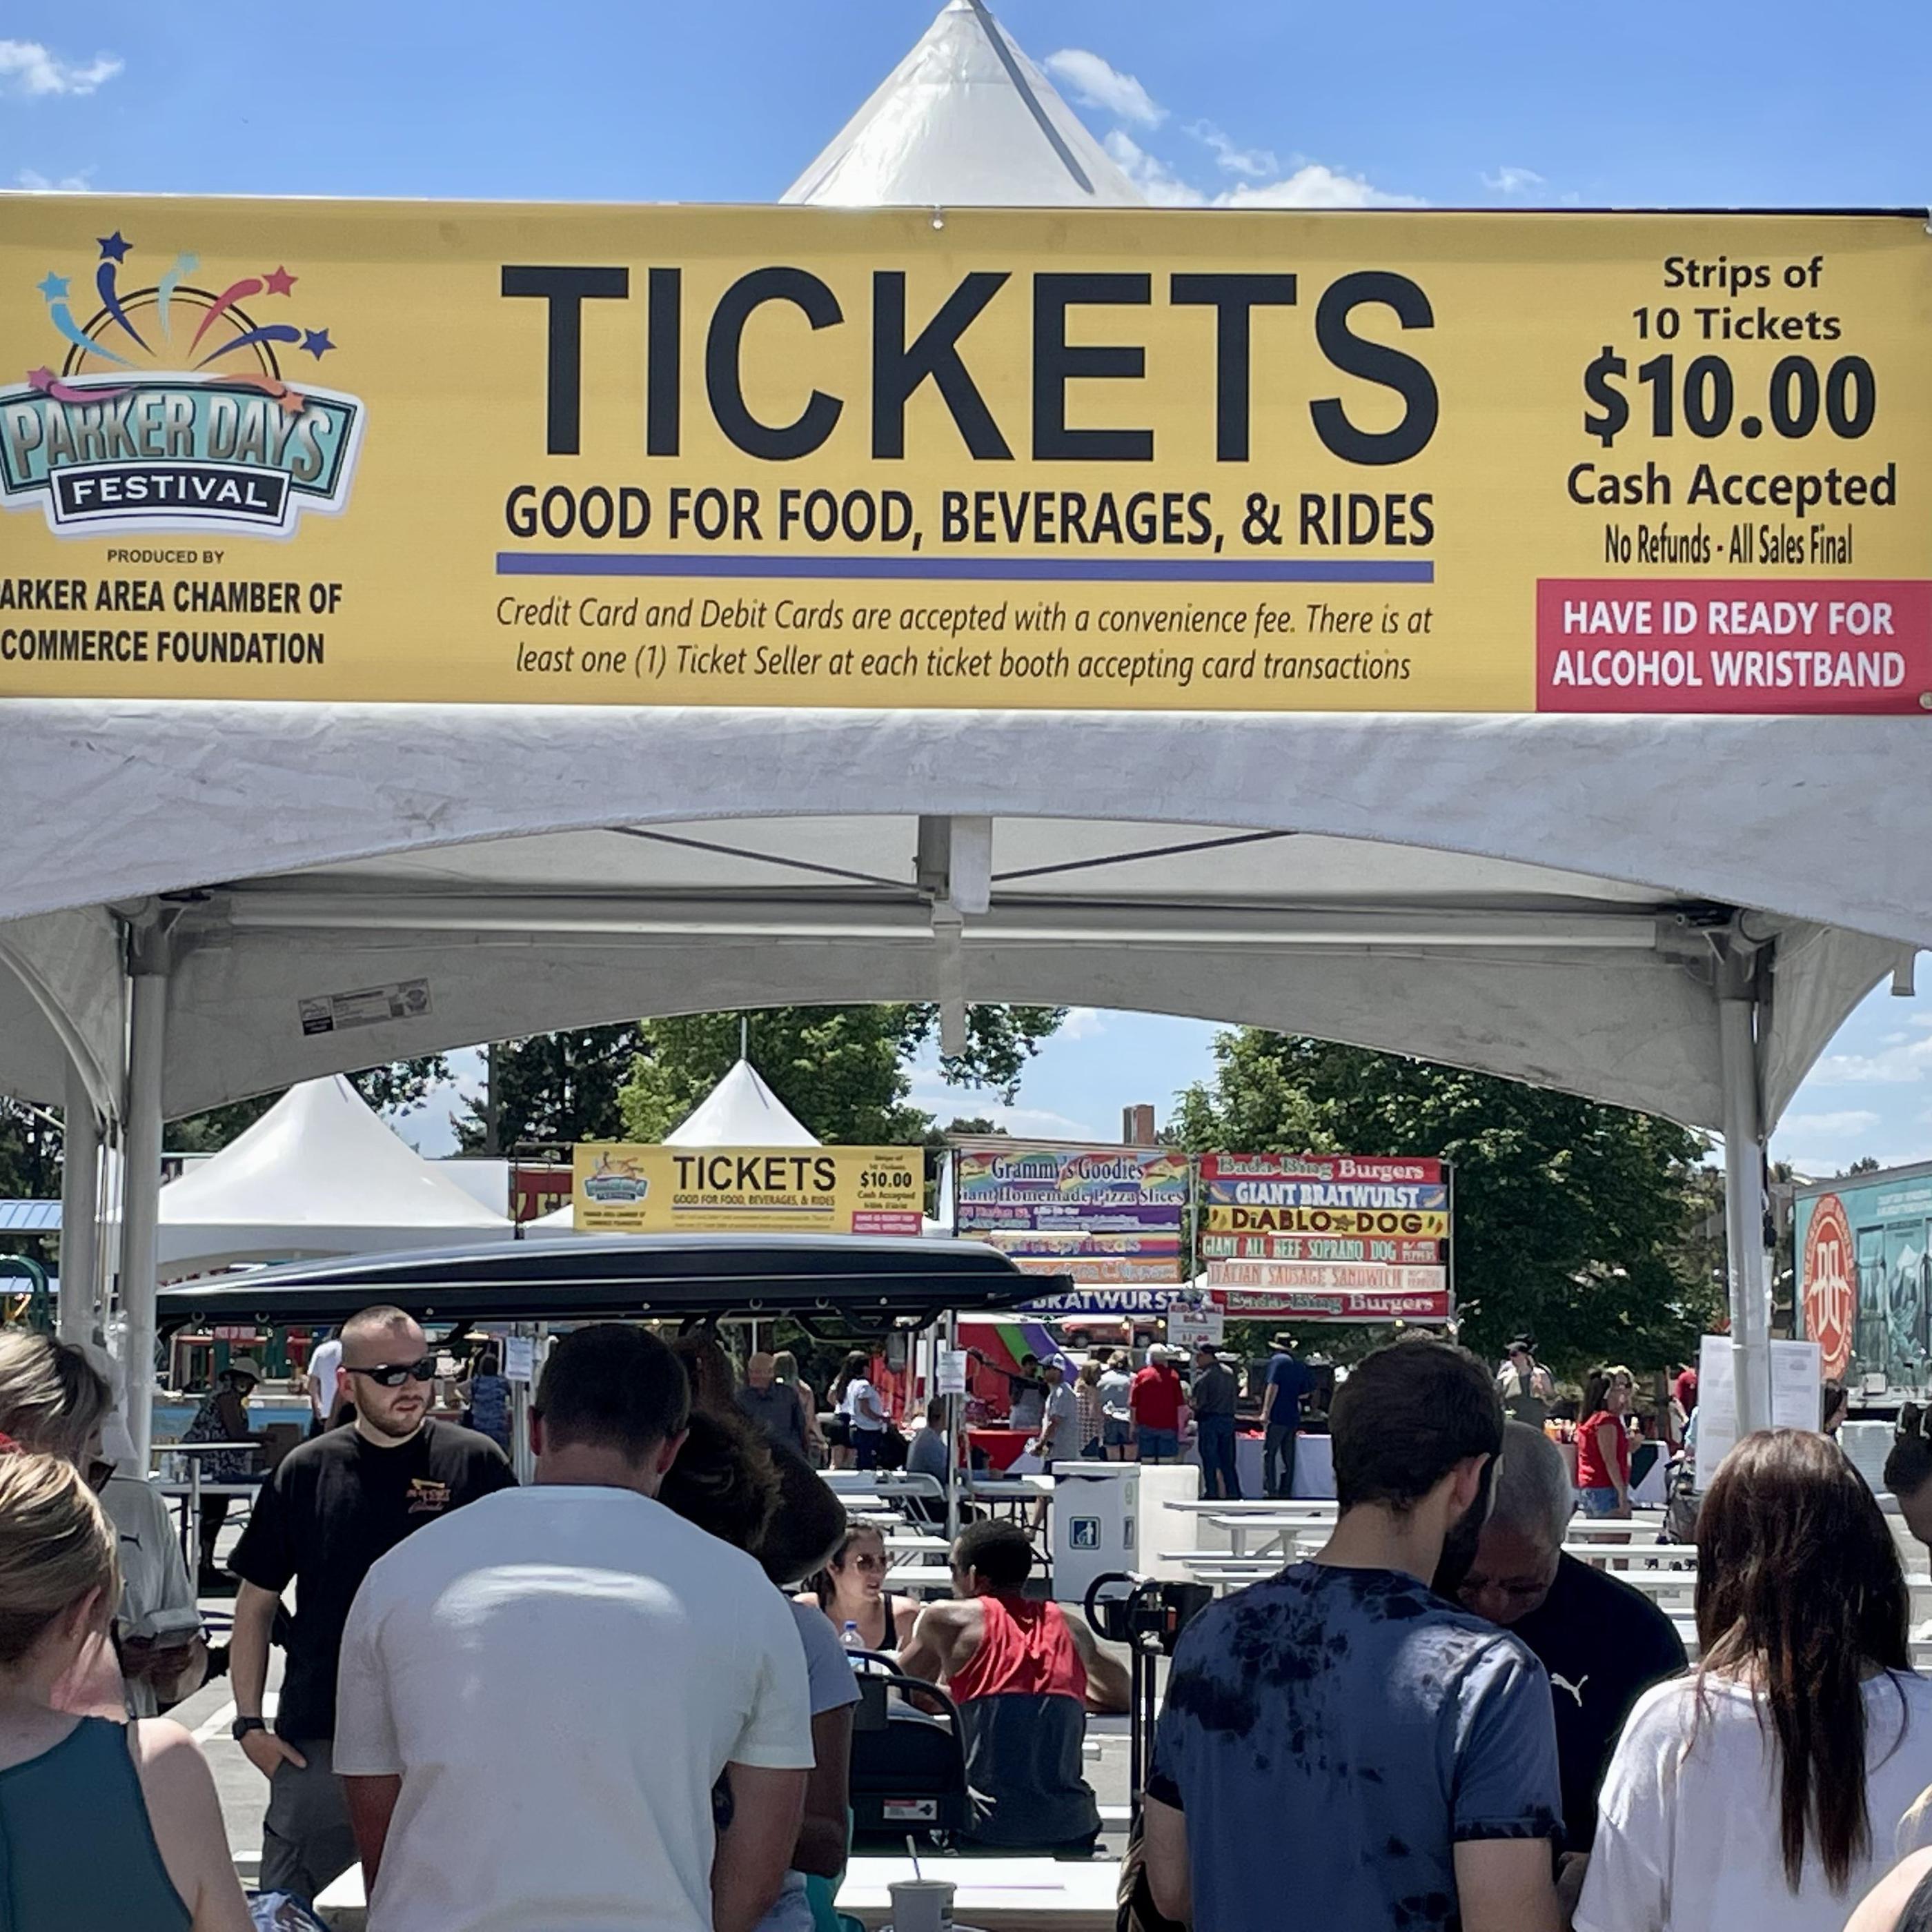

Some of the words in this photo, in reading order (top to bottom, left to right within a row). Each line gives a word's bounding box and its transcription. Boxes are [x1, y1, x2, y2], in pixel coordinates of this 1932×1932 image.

[1664, 256, 1771, 297] Strips
[1784, 255, 1824, 288] of
[1633, 308, 1679, 339] 10
[1694, 308, 1842, 340] Tickets
[502, 266, 1439, 466] TICKETS
[1584, 346, 1876, 447] $10.00
[8, 395, 196, 480] PARKER
[207, 397, 334, 481] DAYS
[72, 475, 268, 507] FESTIVAL
[1567, 462, 1671, 505] Cash
[1687, 462, 1896, 518] Accepted
[506, 486, 651, 538] GOOD
[670, 487, 762, 540] FOR
[779, 489, 922, 551] FOOD,
[942, 491, 1224, 553] BEVERAGES,
[1243, 493, 1283, 545] &
[1300, 493, 1435, 545] RIDES
[108, 549, 197, 563] PRODUCED
[202, 550, 224, 564] BY
[1605, 524, 1631, 564] No
[1637, 523, 1710, 564] Refunds
[1729, 524, 1753, 564] All
[1758, 524, 1804, 564] Sales
[1811, 524, 1853, 564] Final
[0, 579, 87, 611] ARKER
[95, 580, 165, 611] AREA
[174, 581, 300, 613] CHAMBER
[310, 582, 343, 613] OF
[497, 596, 571, 627] Credit
[579, 598, 638, 628] Card
[646, 598, 693, 628] and
[700, 598, 767, 629] Debit
[775, 600, 843, 630] Cards
[852, 607, 891, 630] are
[900, 600, 1007, 637] accepted
[1015, 602, 1066, 632] with
[1075, 610, 1090, 632] a
[1098, 603, 1247, 633] convenience
[1254, 604, 1296, 638] fee.
[1307, 604, 1373, 634] There
[1381, 604, 1399, 634] is
[1407, 608, 1433, 634] at
[1564, 600, 1652, 634] HAVE
[1662, 601, 1697, 635] ID
[1708, 601, 1817, 635] READY
[1828, 601, 1893, 635] FOR
[1, 629, 148, 662] COMMERCE
[157, 631, 324, 663] FOUNDATION
[517, 642, 573, 672] least
[581, 650, 627, 673] one
[635, 644, 667, 678] (1)
[677, 644, 747, 675] Ticket
[755, 646, 822, 676] Seller
[829, 650, 855, 676] at
[862, 646, 918, 676] each
[927, 647, 992, 676] ticket
[1000, 648, 1070, 678] booth
[1078, 649, 1194, 686] accepting
[1202, 650, 1255, 680] card
[1263, 649, 1410, 680] transactions
[1552, 650, 1702, 686] ALCOHOL
[1710, 651, 1905, 687] WRISTBAND
[673, 1156, 836, 1191] TICKETS
[860, 1170, 912, 1188] $10.00
[1078, 1156, 1145, 1181] Goodies
[1339, 1159, 1424, 1181] Burgers
[701, 1195, 718, 1205] FOR
[960, 1187, 998, 1204] iant
[1094, 1187, 1137, 1204] Pizza
[1140, 1188, 1184, 1205] Slices
[1236, 1182, 1297, 1205] GIANT
[1300, 1183, 1419, 1208] BRATWURST
[1357, 1212, 1422, 1233] DOG
[1370, 1241, 1396, 1260] DOG
[1269, 1265, 1326, 1287] SAUSAGE
[1332, 1266, 1403, 1288] SANDWICH
[1033, 1291, 1180, 1310] BRATWURST
[1348, 1294, 1433, 1314] Burgers
